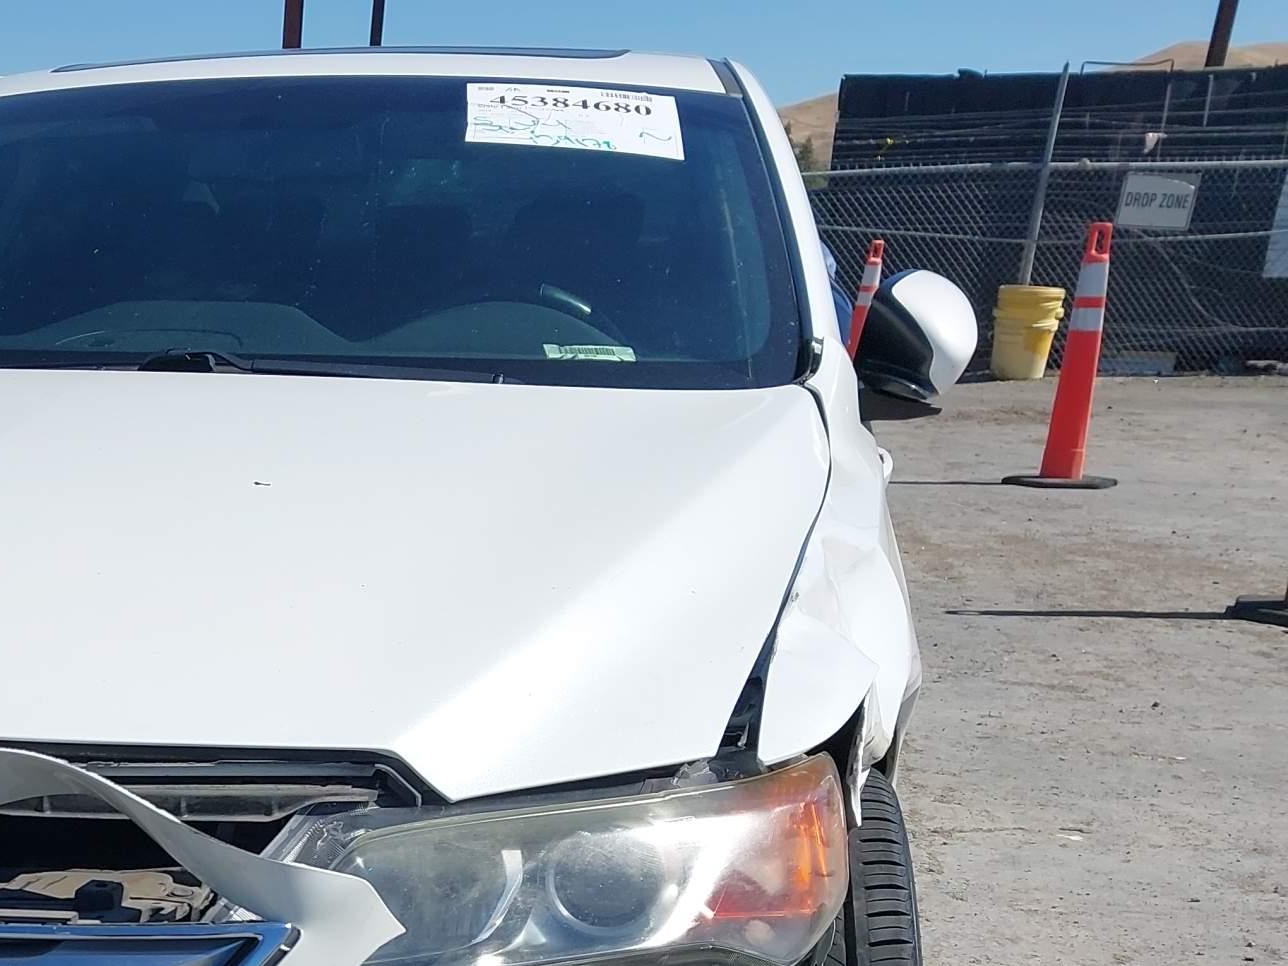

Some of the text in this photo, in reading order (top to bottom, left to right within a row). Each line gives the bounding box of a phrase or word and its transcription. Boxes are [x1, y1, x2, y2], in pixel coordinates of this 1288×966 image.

[489, 95, 652, 116] 45384680
[1125, 192, 1190, 208] DROP ZONE
